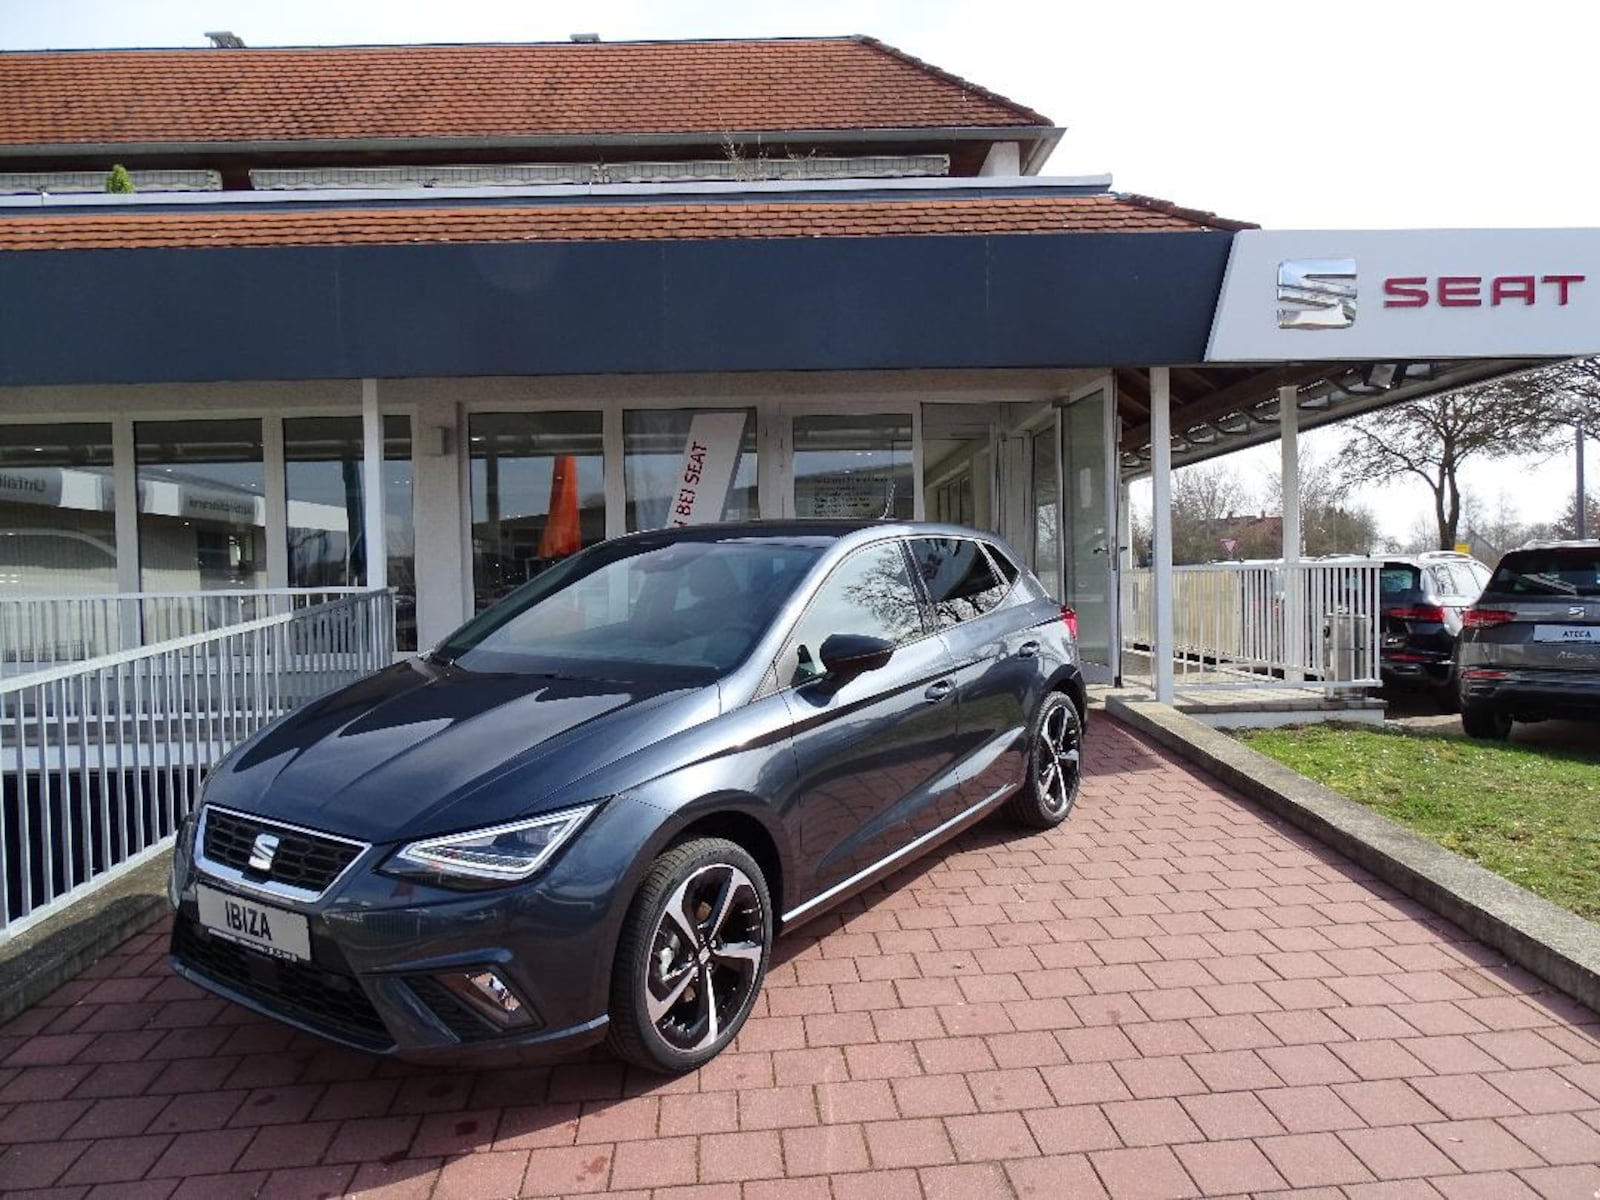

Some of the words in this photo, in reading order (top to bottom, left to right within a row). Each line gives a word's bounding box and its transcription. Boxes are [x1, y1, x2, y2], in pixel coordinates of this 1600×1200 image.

[1383, 275, 1586, 309] SEAT
[684, 440, 708, 485] SEAT
[675, 488, 696, 516] BEI
[1562, 630, 1592, 638] ATECA
[224, 900, 273, 942] IBIZA
